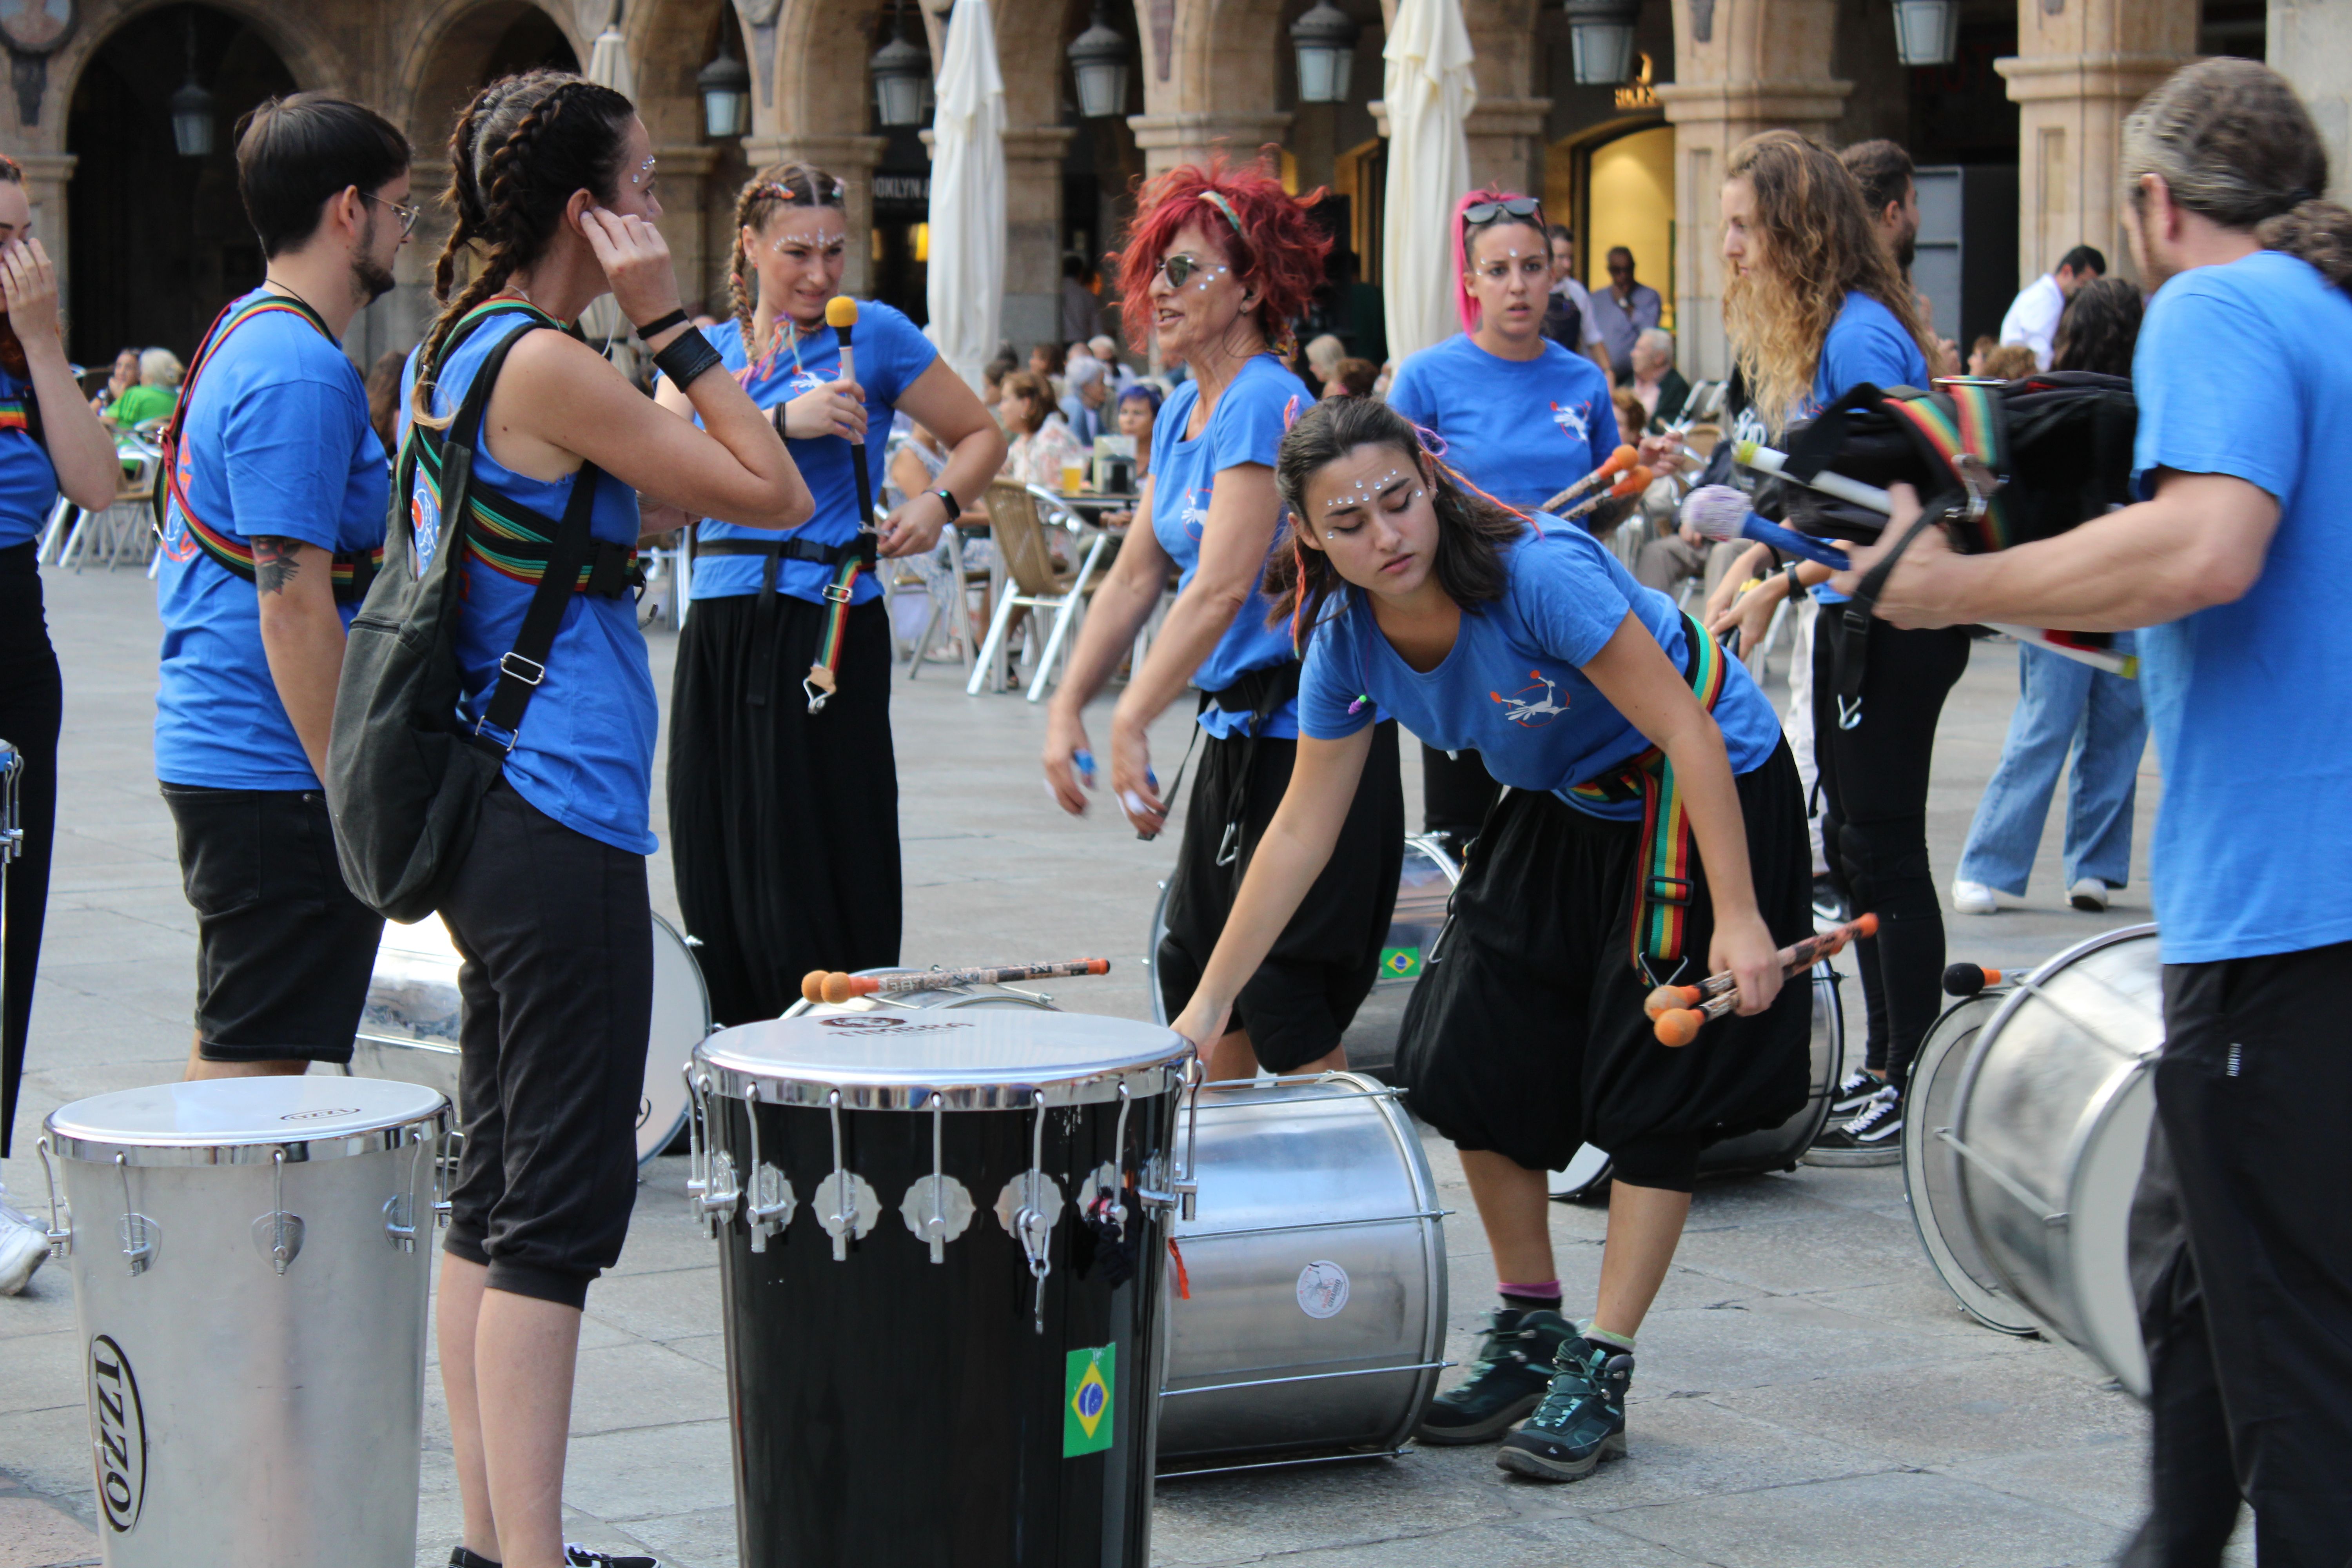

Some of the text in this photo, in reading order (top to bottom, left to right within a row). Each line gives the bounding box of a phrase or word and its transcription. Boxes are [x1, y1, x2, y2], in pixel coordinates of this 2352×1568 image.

[871, 177, 921, 199] OKLYN
[827, 1022, 975, 1037] TIMBRA
[94, 1351, 131, 1513] IZZO
